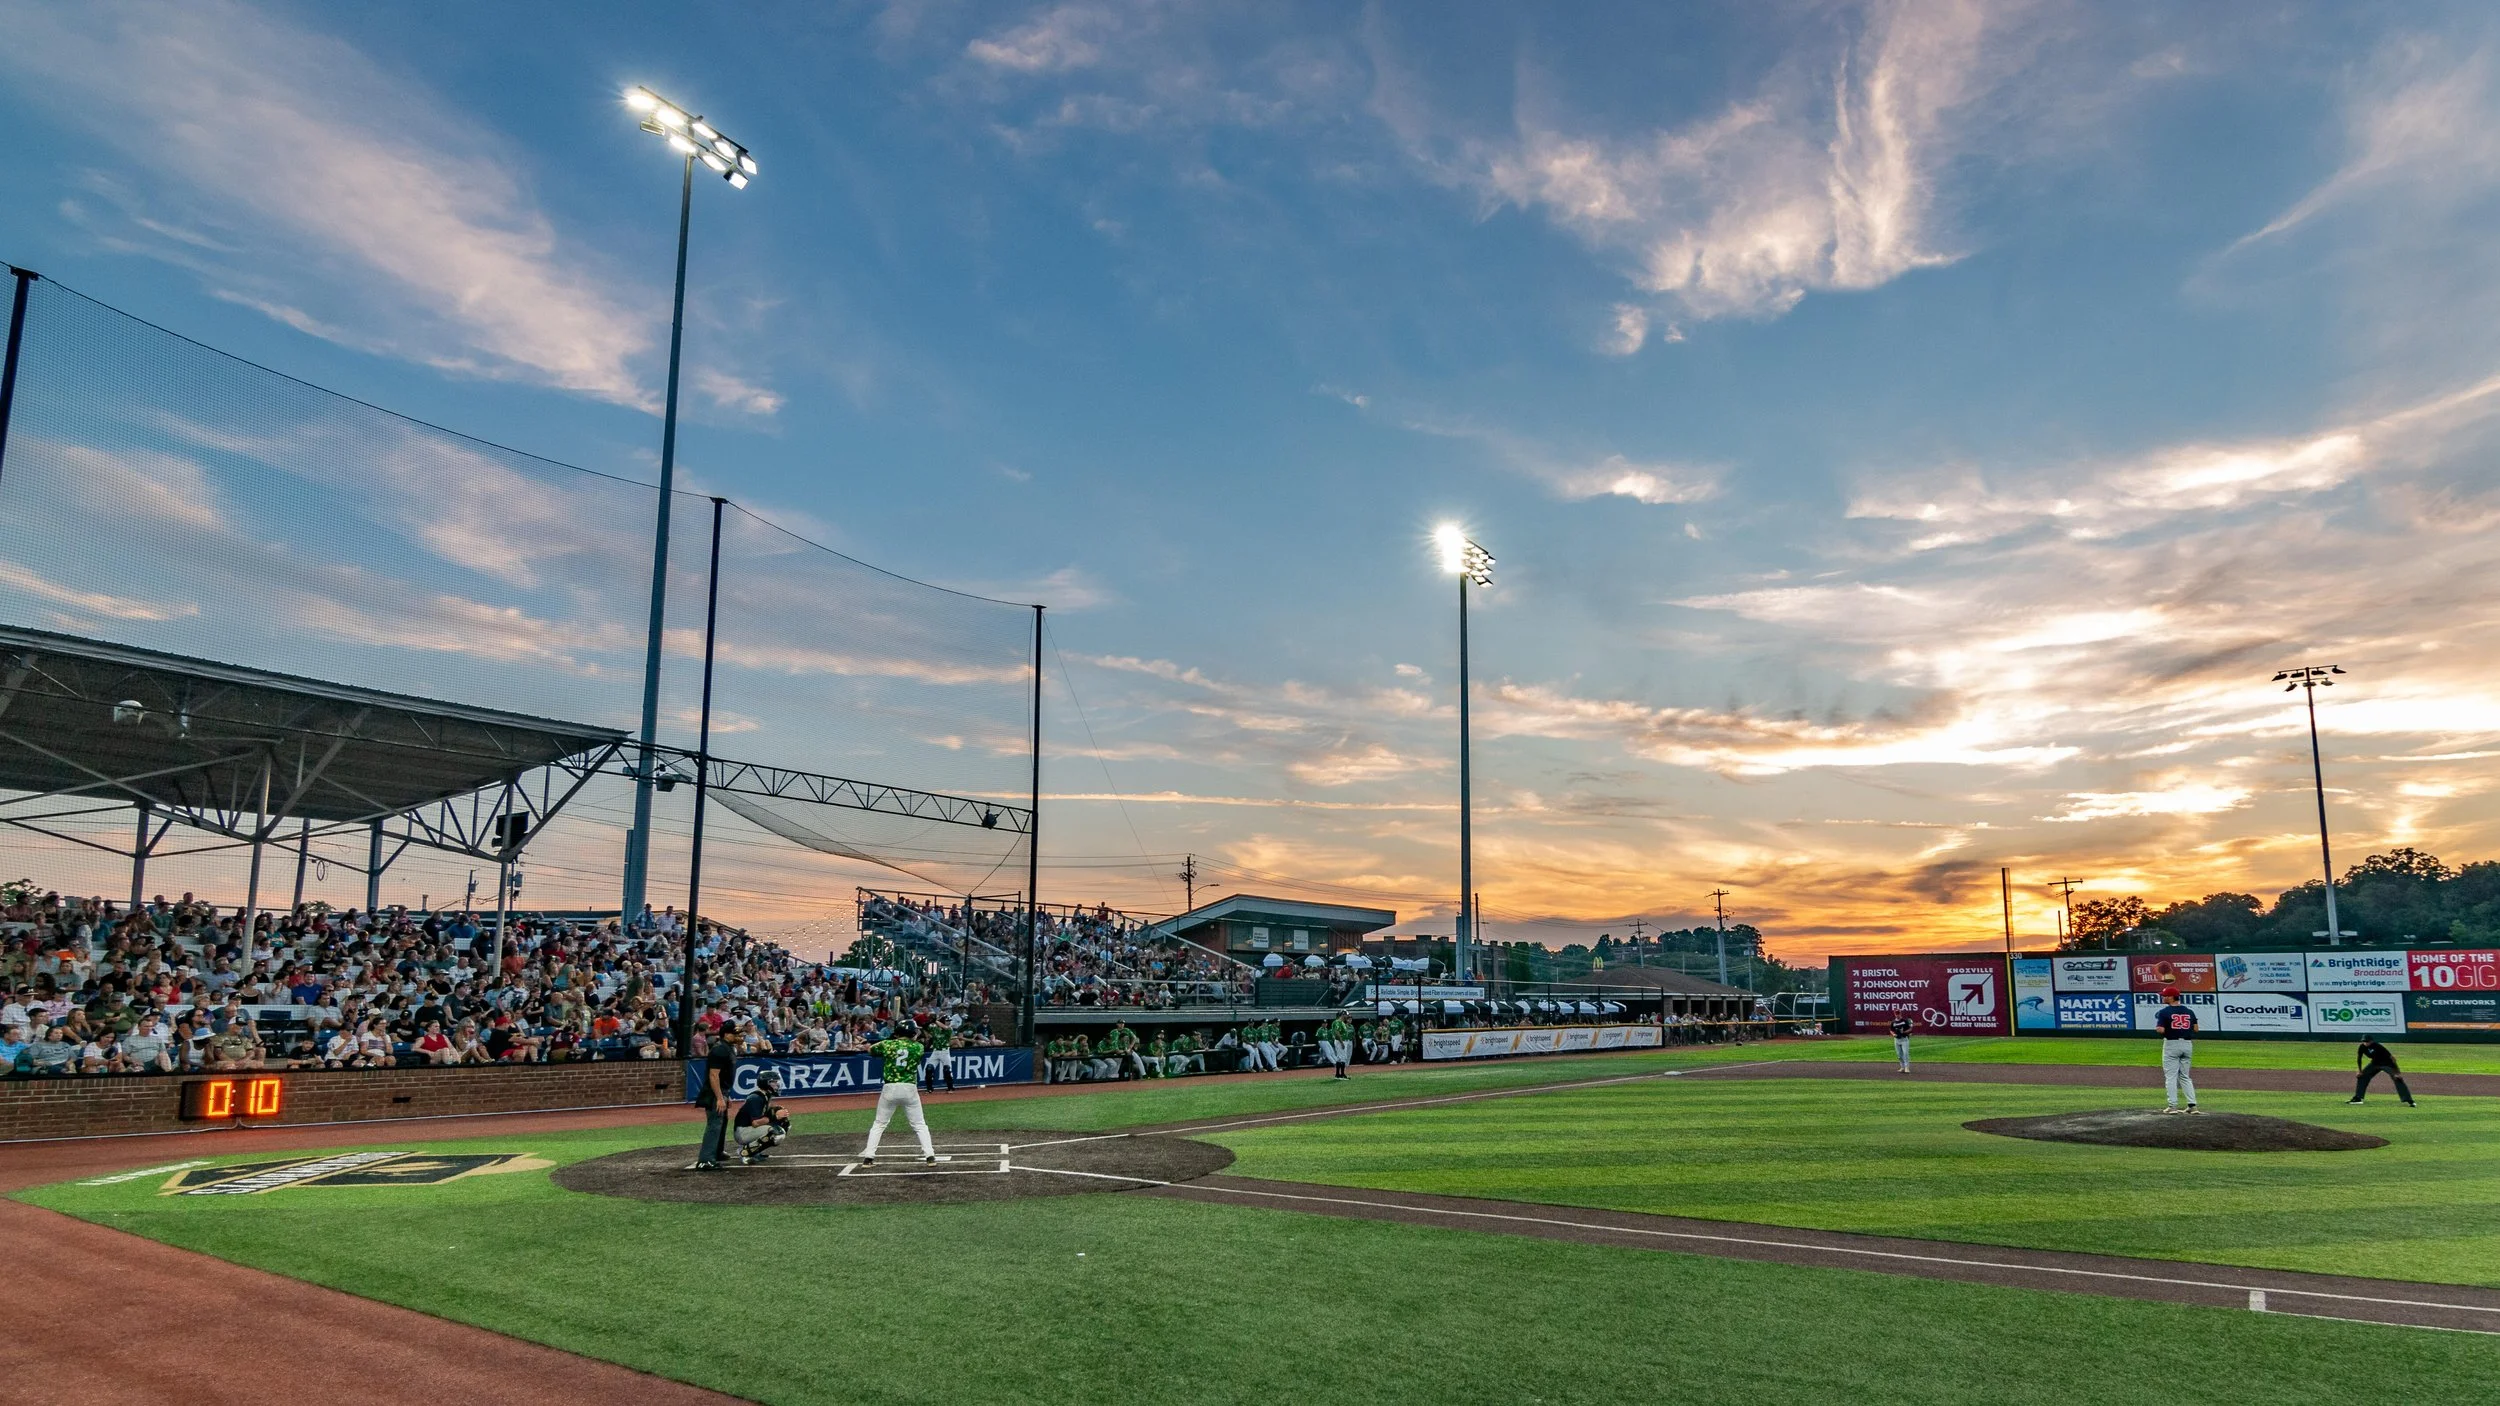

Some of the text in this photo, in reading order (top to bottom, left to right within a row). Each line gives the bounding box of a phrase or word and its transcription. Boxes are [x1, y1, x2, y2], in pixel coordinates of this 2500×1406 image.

[2009, 952, 2023, 960] 330
[2412, 953, 2495, 963] HOME OF THE
[2063, 961, 2104, 971] CASE
[2328, 958, 2400, 969] BrightRidge
[1862, 969, 1899, 977] BRISTOL
[2137, 967, 2151, 975] ELM
[2142, 974, 2158, 982] HILL
[1862, 980, 1930, 988] JOHNSON CITY
[1863, 992, 1915, 1000] KINGSPORT
[2135, 994, 2216, 1005] PRIER
[1864, 1003, 1918, 1012] PINEY FLATS
[1949, 1000, 1967, 1014] TVA
[2060, 998, 2126, 1009] MARTY'S
[2224, 1005, 2288, 1014] Goodwill
[2321, 1008, 2391, 1021] 150 years
[2061, 1011, 2126, 1022] ELECTRIC
[2171, 1014, 2191, 1029] 25
[1434, 1039, 1460, 1048] brightspeed
[1485, 1037, 1508, 1045] brightspeed
[895, 1048, 909, 1067] 2
[732, 1062, 855, 1095] GARZA
[207, 1080, 280, 1116] 0:10
